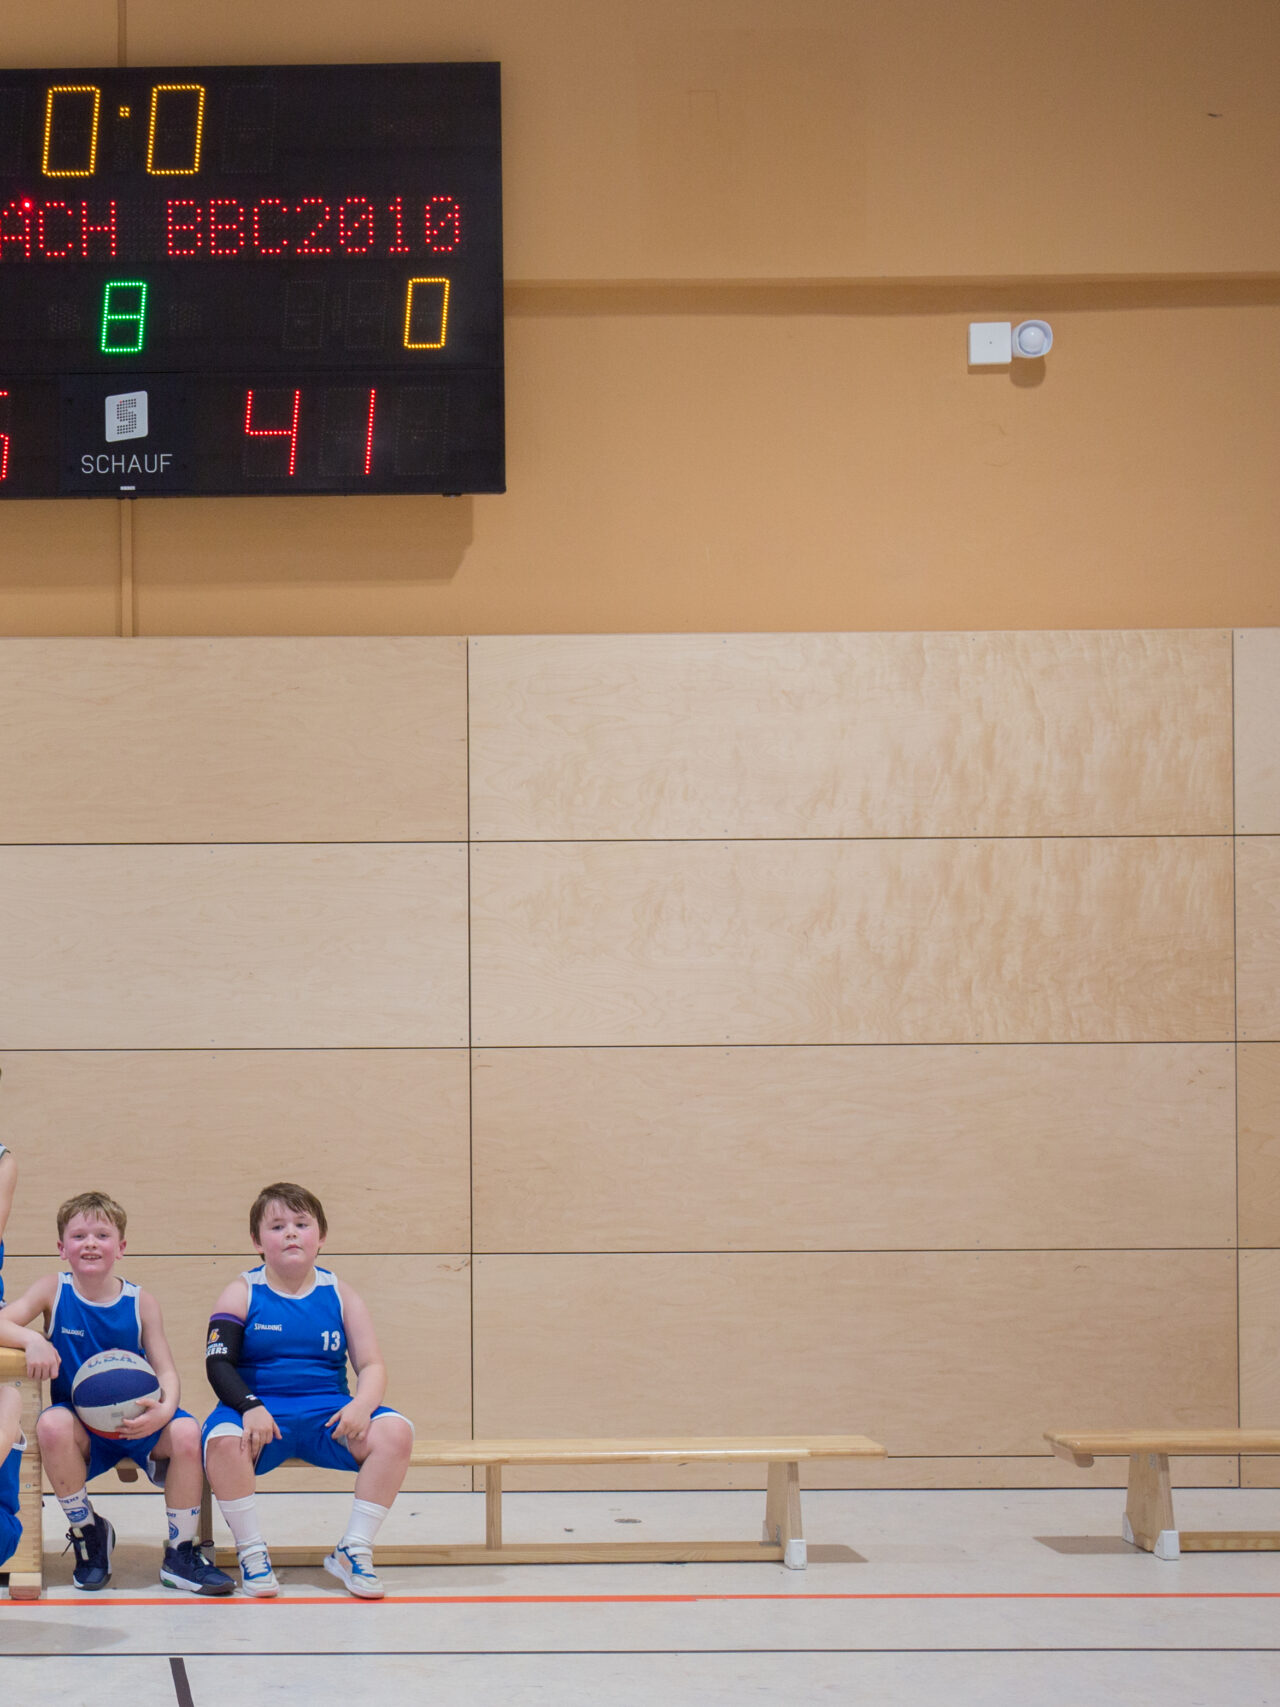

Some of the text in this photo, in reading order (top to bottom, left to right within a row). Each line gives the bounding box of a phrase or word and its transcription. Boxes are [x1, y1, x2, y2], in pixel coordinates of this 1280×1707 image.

[167, 196, 462, 256] BBC2010
[100, 280, 148, 353] 8
[403, 276, 451, 350] 0
[81, 453, 173, 474] SCHAUF
[254, 1323, 283, 1332] SPALDING
[321, 1330, 341, 1351] 13
